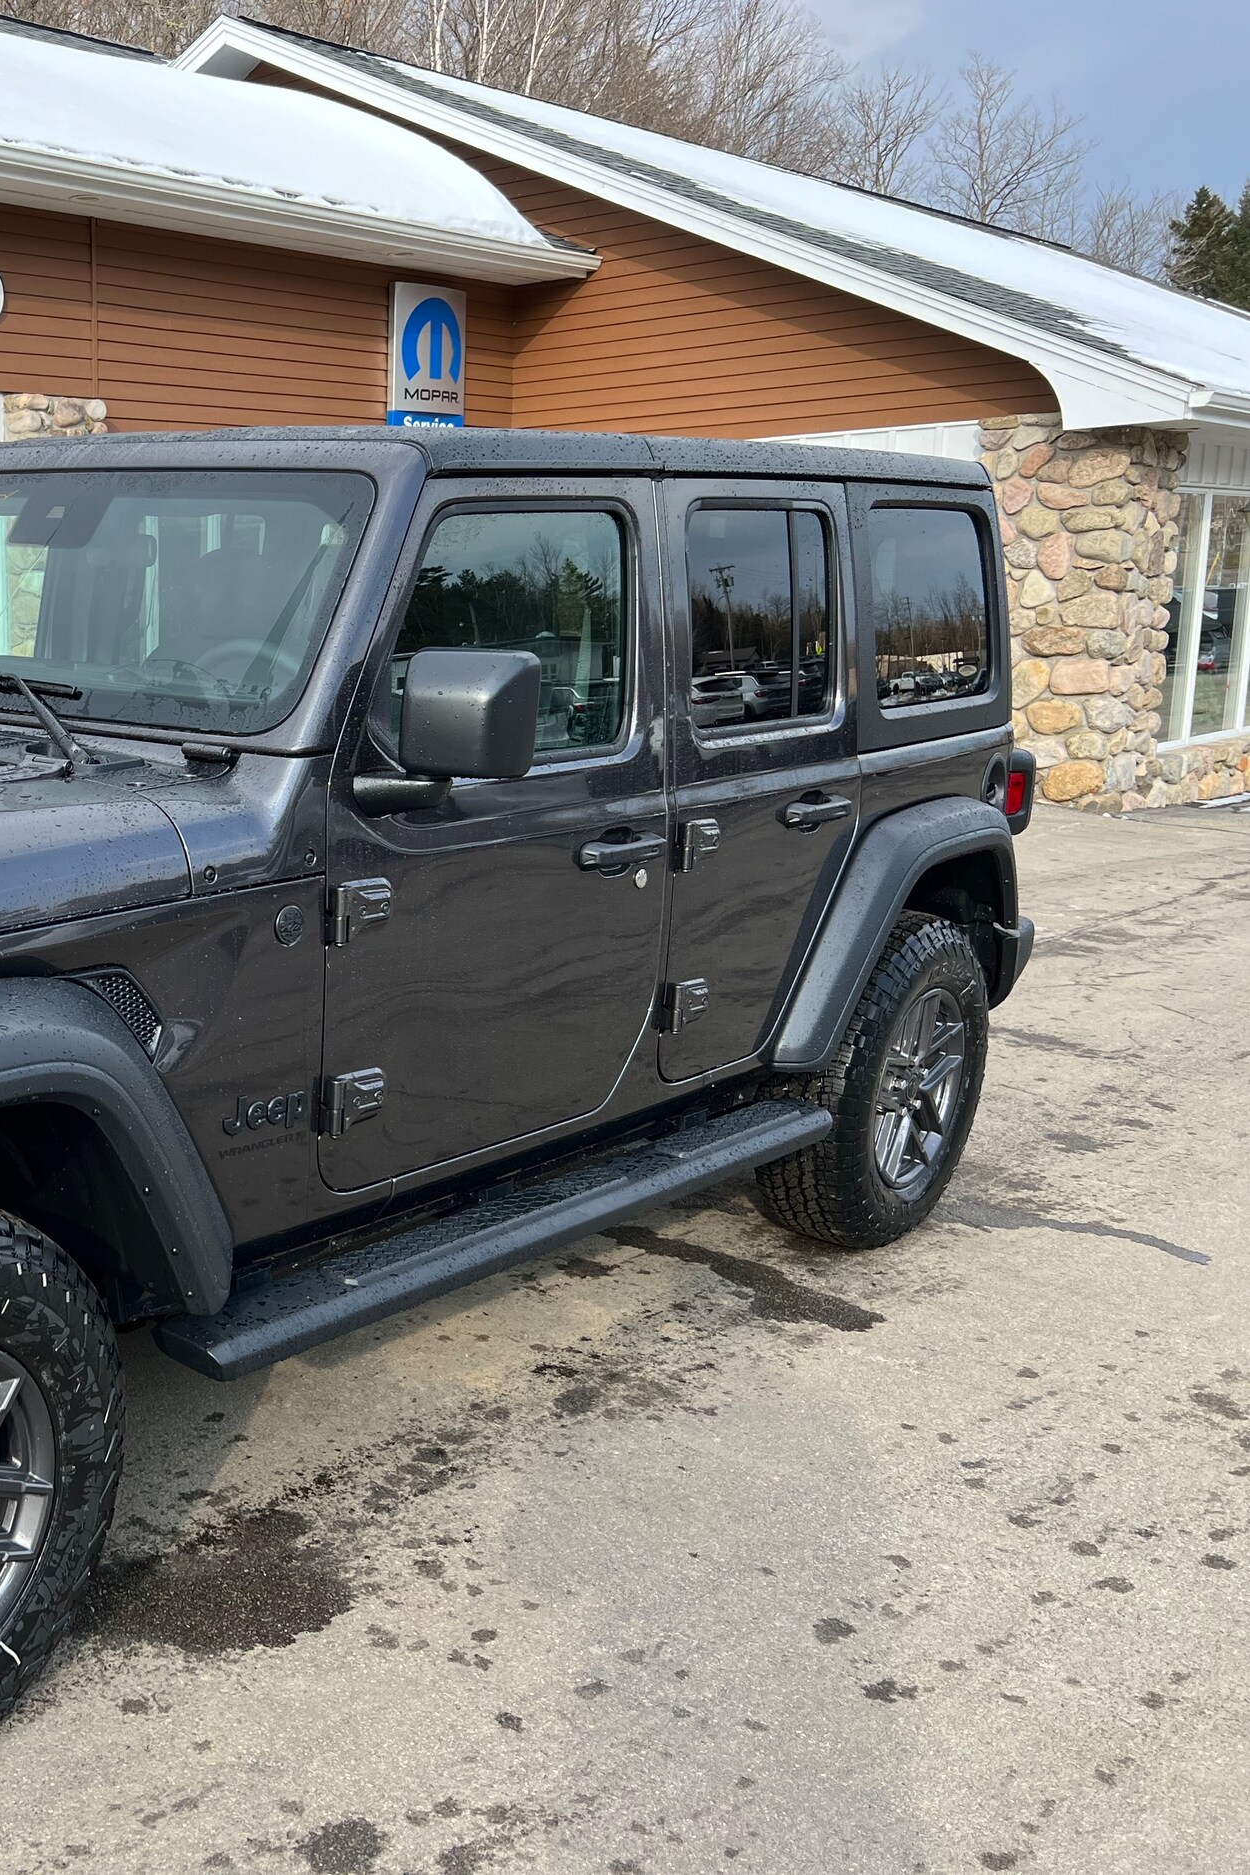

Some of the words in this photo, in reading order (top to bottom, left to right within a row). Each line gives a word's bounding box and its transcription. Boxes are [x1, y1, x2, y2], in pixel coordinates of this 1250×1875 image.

[404, 387, 459, 404] MOPAR
[222, 1090, 308, 1137] Jeep
[217, 1133, 294, 1161] WRANGLER
